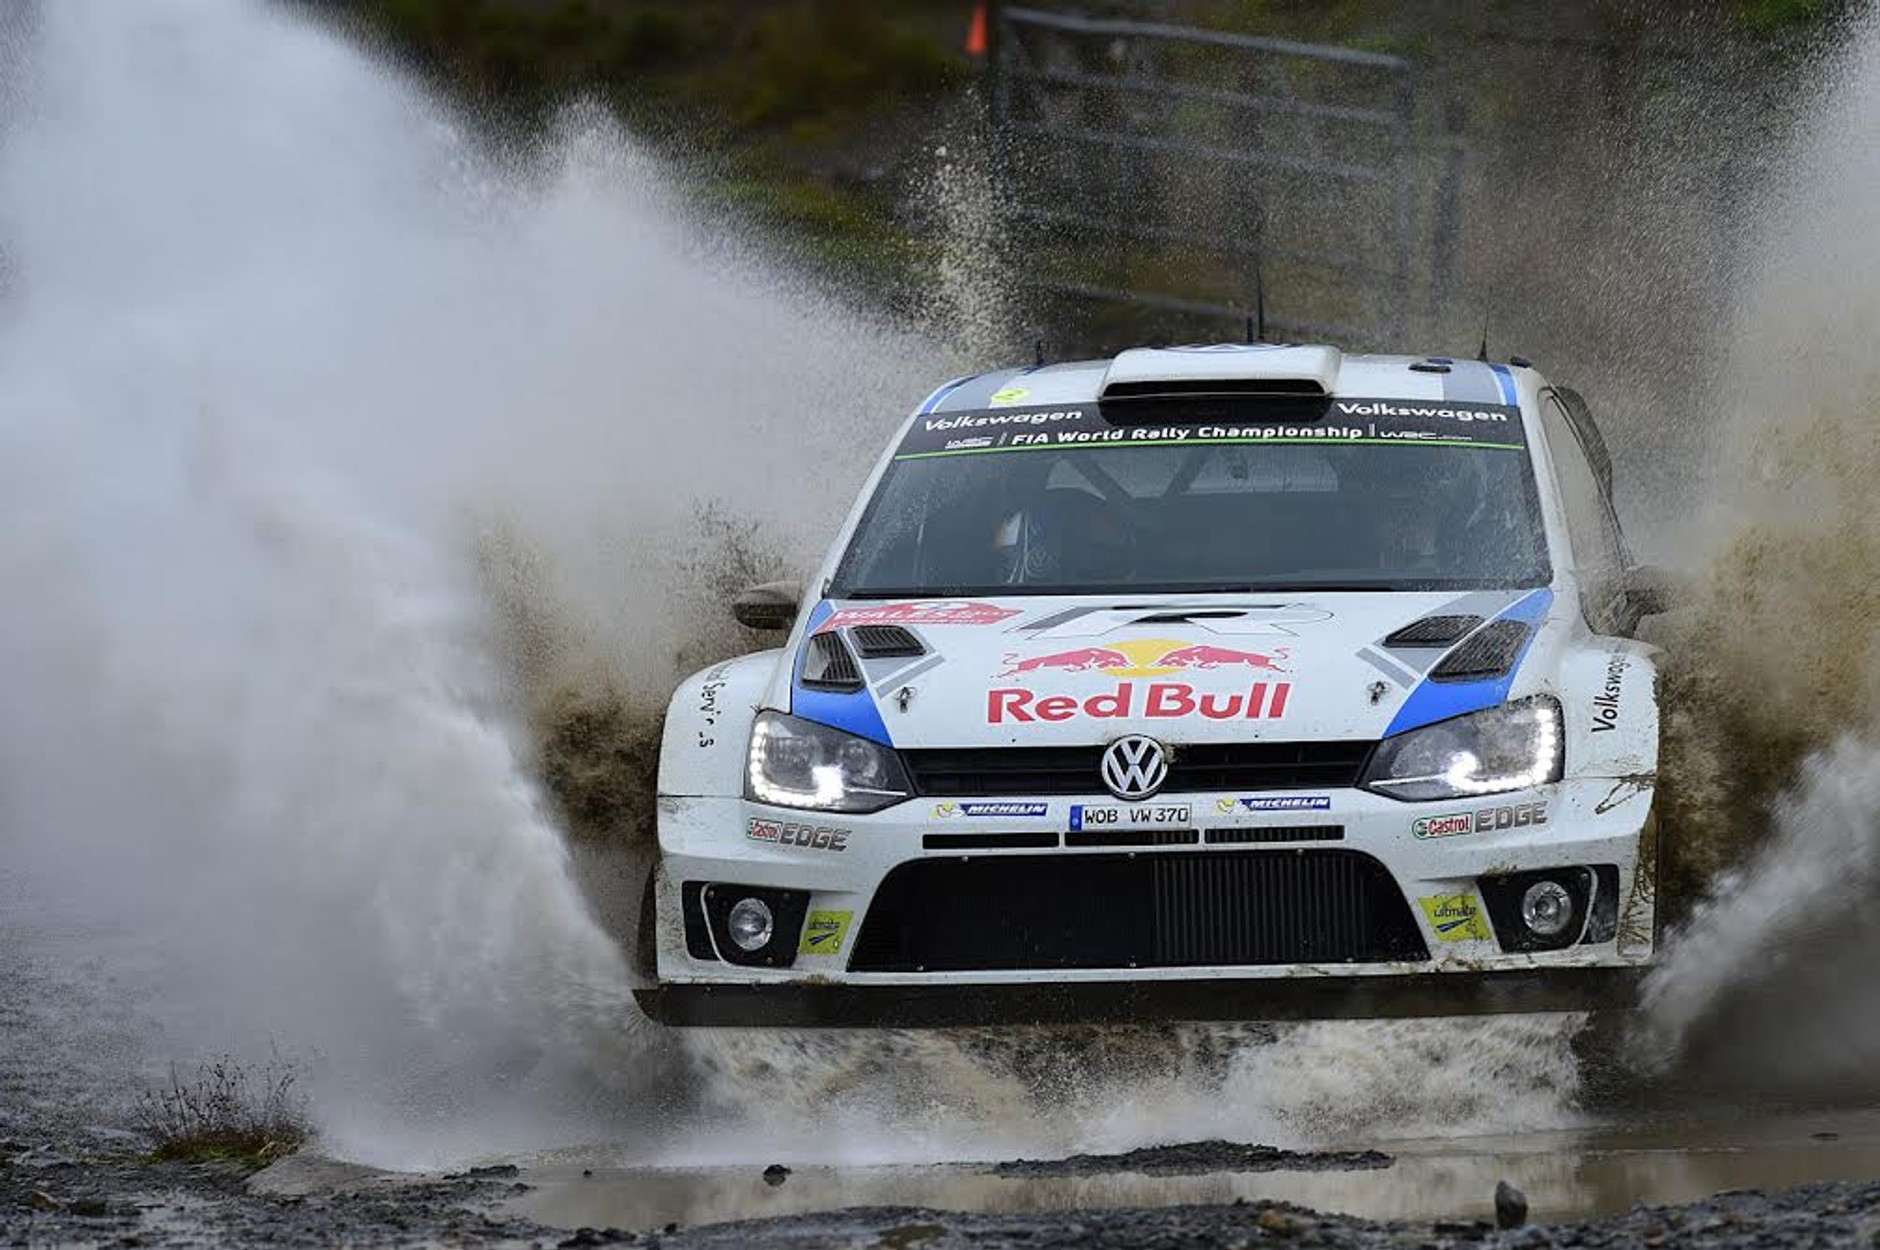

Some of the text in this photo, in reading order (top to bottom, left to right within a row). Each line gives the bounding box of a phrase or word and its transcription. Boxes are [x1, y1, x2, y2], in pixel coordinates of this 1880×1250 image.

[925, 411, 1083, 431] Volkswagen
[1338, 402, 1508, 421] Volkswagen
[1012, 426, 1363, 445] FIA World Rally Championship
[987, 682, 1291, 724] Red Bull
[967, 804, 1046, 815] MICHELIN
[1250, 798, 1329, 809] MICHELIN
[1084, 806, 1189, 824] WOB VW 370
[1428, 801, 1548, 835] Castrol EDGE
[779, 822, 853, 852] EDGE
